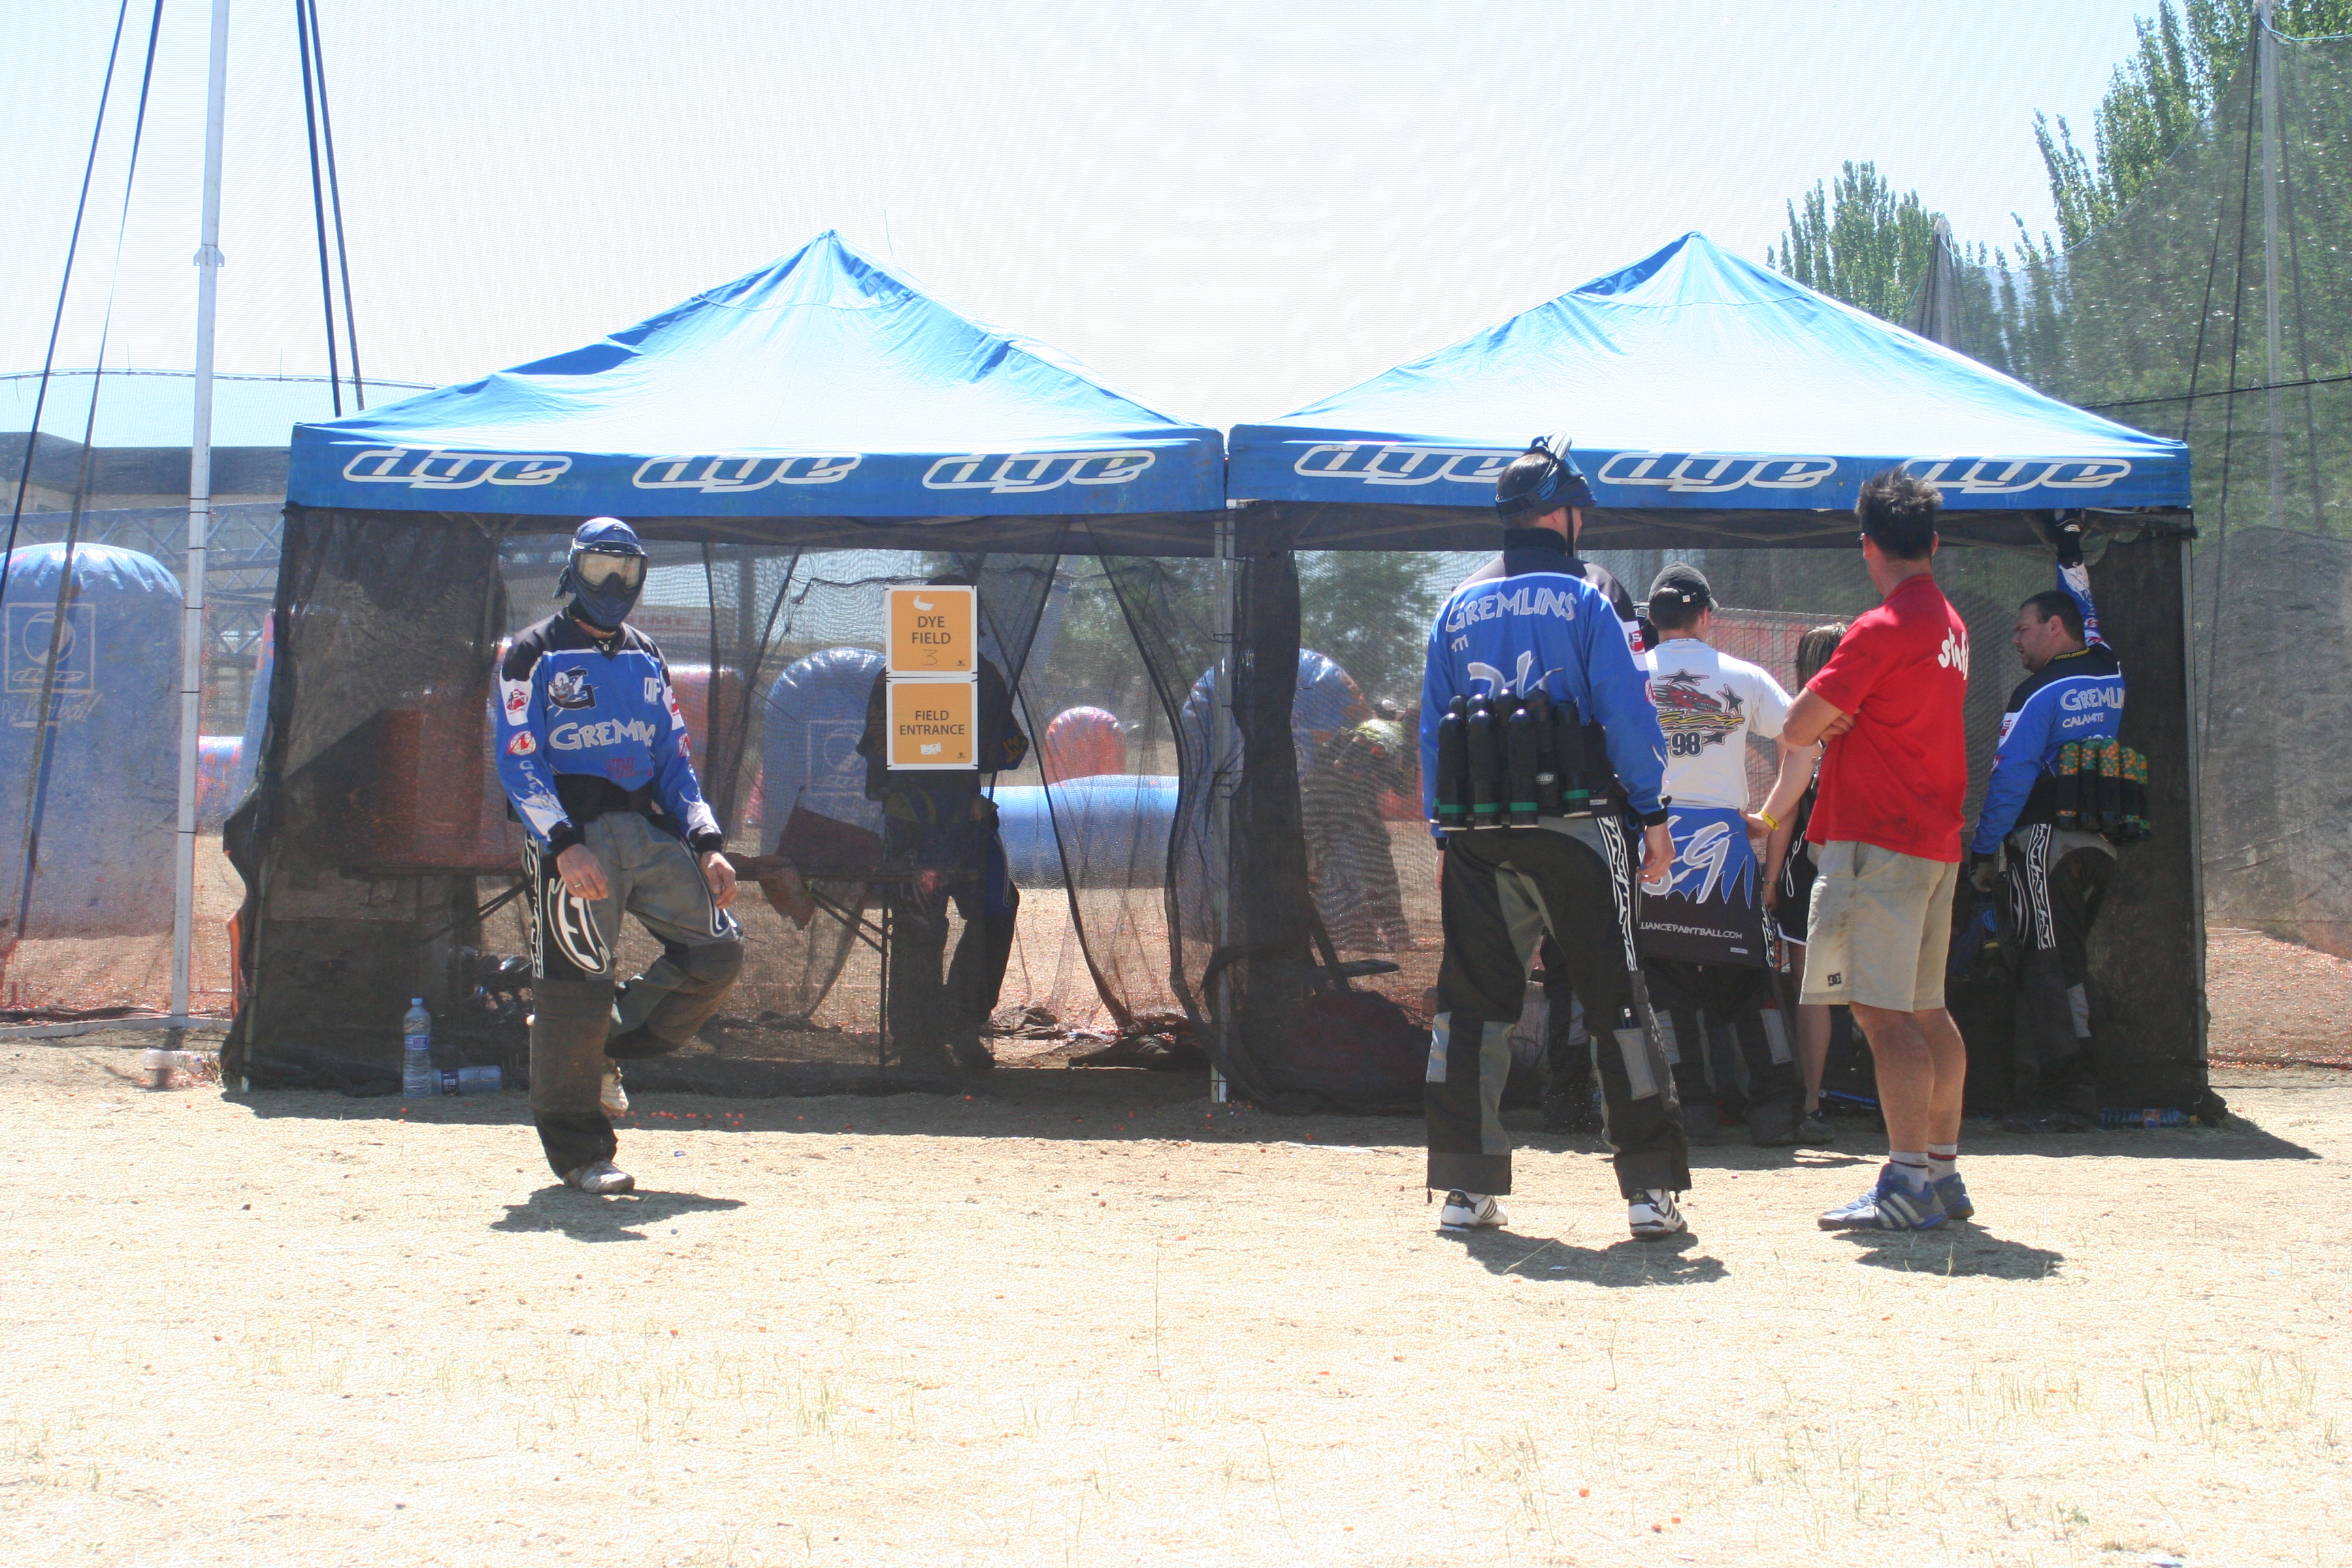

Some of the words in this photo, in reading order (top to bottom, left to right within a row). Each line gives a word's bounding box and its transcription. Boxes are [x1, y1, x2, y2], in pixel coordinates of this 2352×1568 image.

[343, 444, 572, 489] dye
[632, 451, 862, 493] dye
[922, 449, 1156, 493] dye
[1598, 448, 1837, 492] dye
[917, 615, 945, 628] DYE
[1446, 587, 1577, 632] GREMLINS
[911, 632, 951, 644] FIELD
[921, 649, 938, 666] 3
[915, 710, 949, 721] FIELD
[899, 724, 965, 736] ENTRANCE
[1669, 730, 1703, 758] 98
